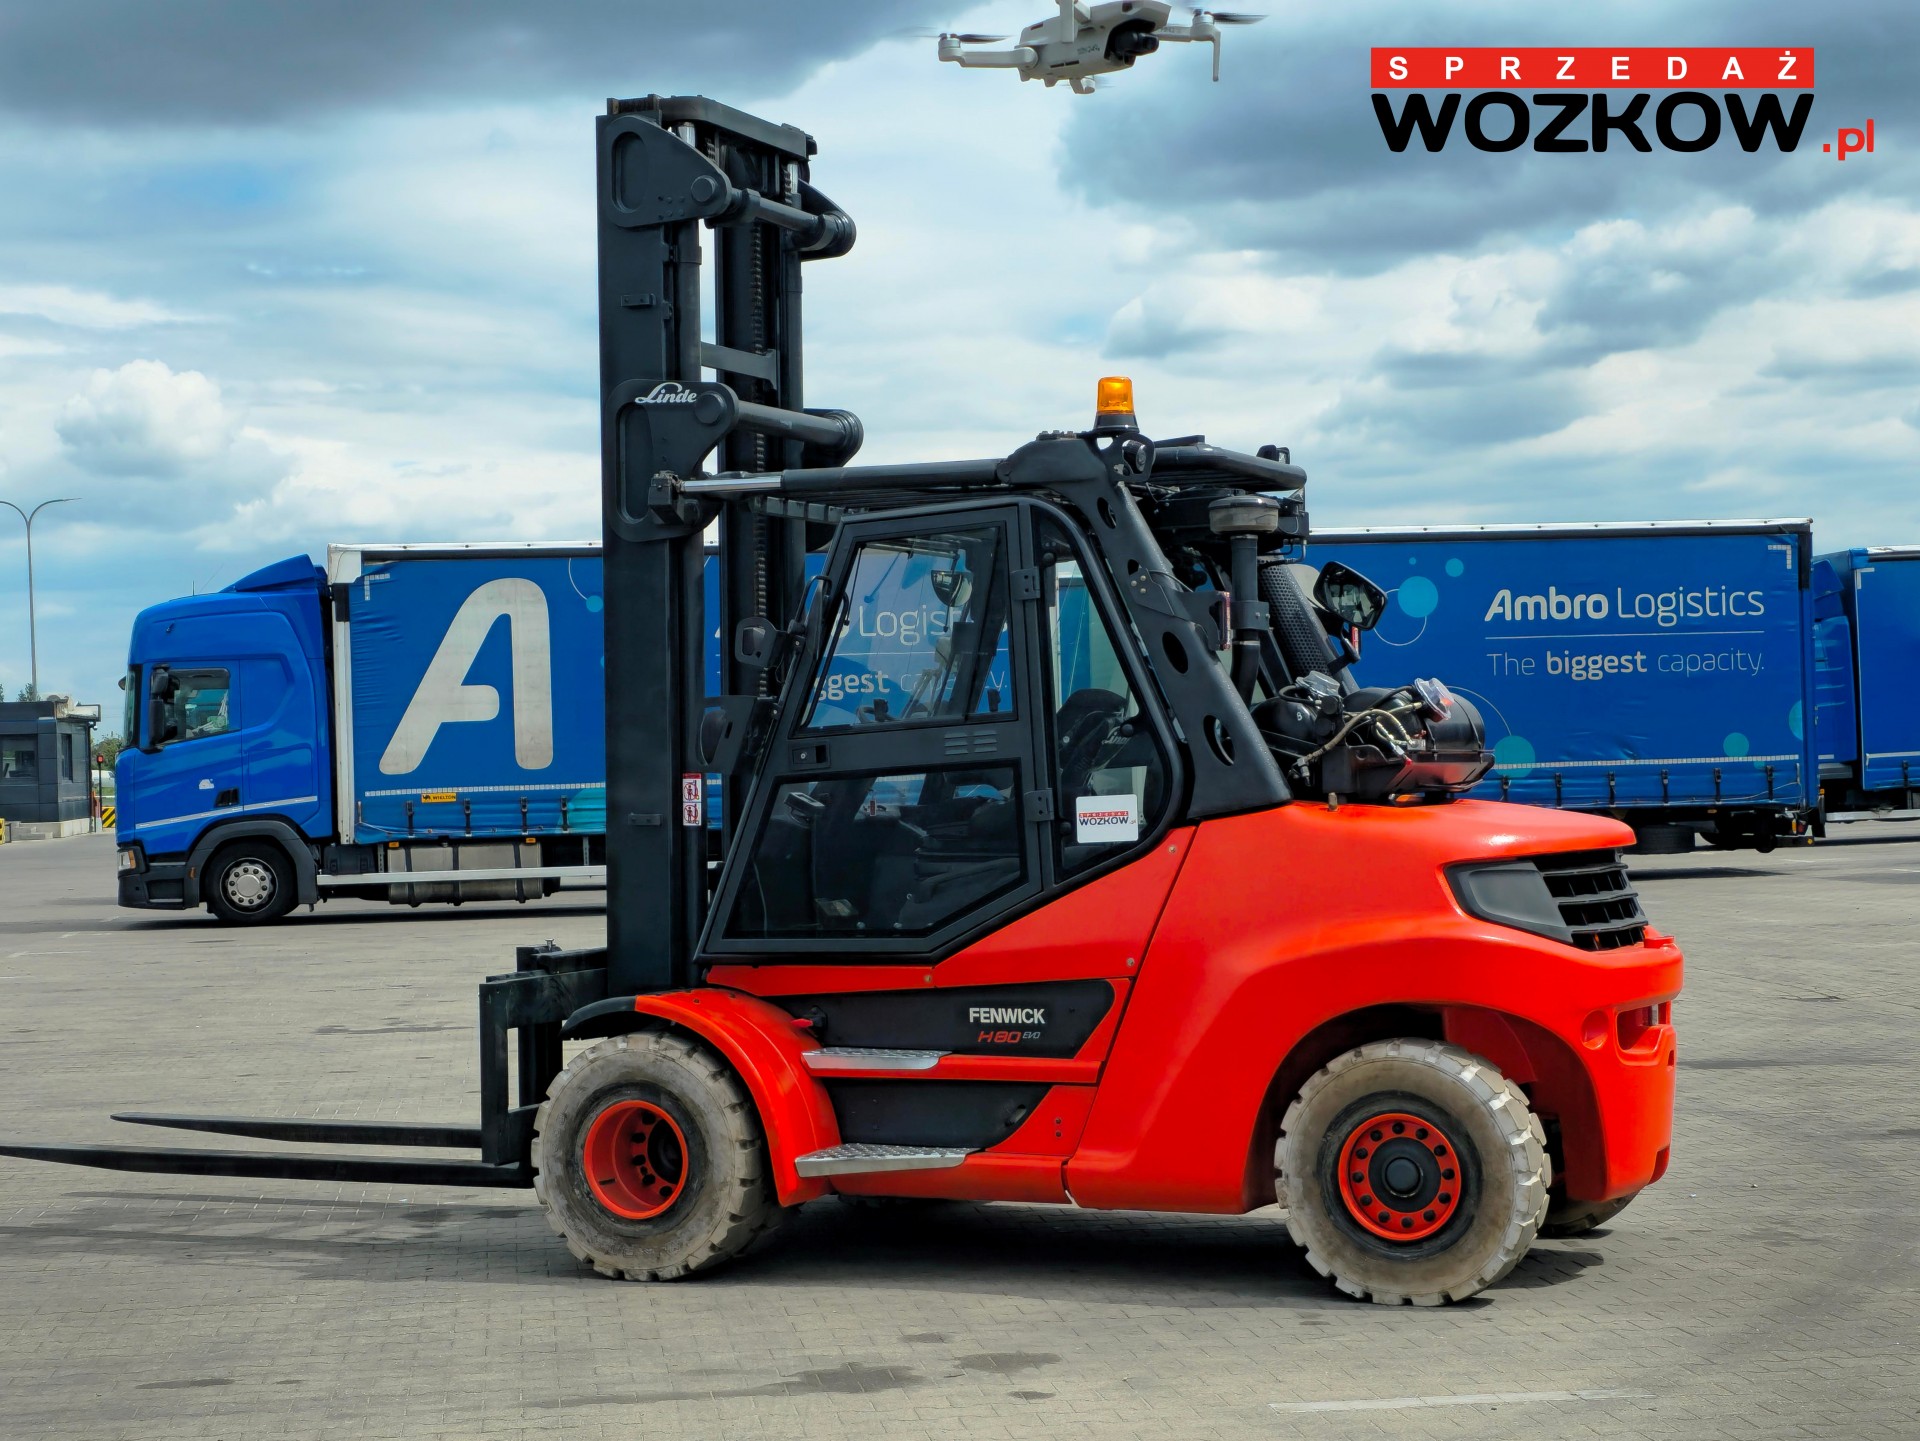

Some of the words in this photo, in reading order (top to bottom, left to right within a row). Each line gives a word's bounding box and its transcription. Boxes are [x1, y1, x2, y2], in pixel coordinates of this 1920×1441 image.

[634, 382, 697, 404] Linde
[1484, 586, 1609, 621] Ambro
[1617, 585, 1765, 627] Logistics
[378, 577, 553, 775] A
[1486, 652, 1535, 676] The
[1546, 650, 1648, 681] biggest
[1658, 648, 1765, 677] capacity.
[969, 1008, 1046, 1024] FENWICK
